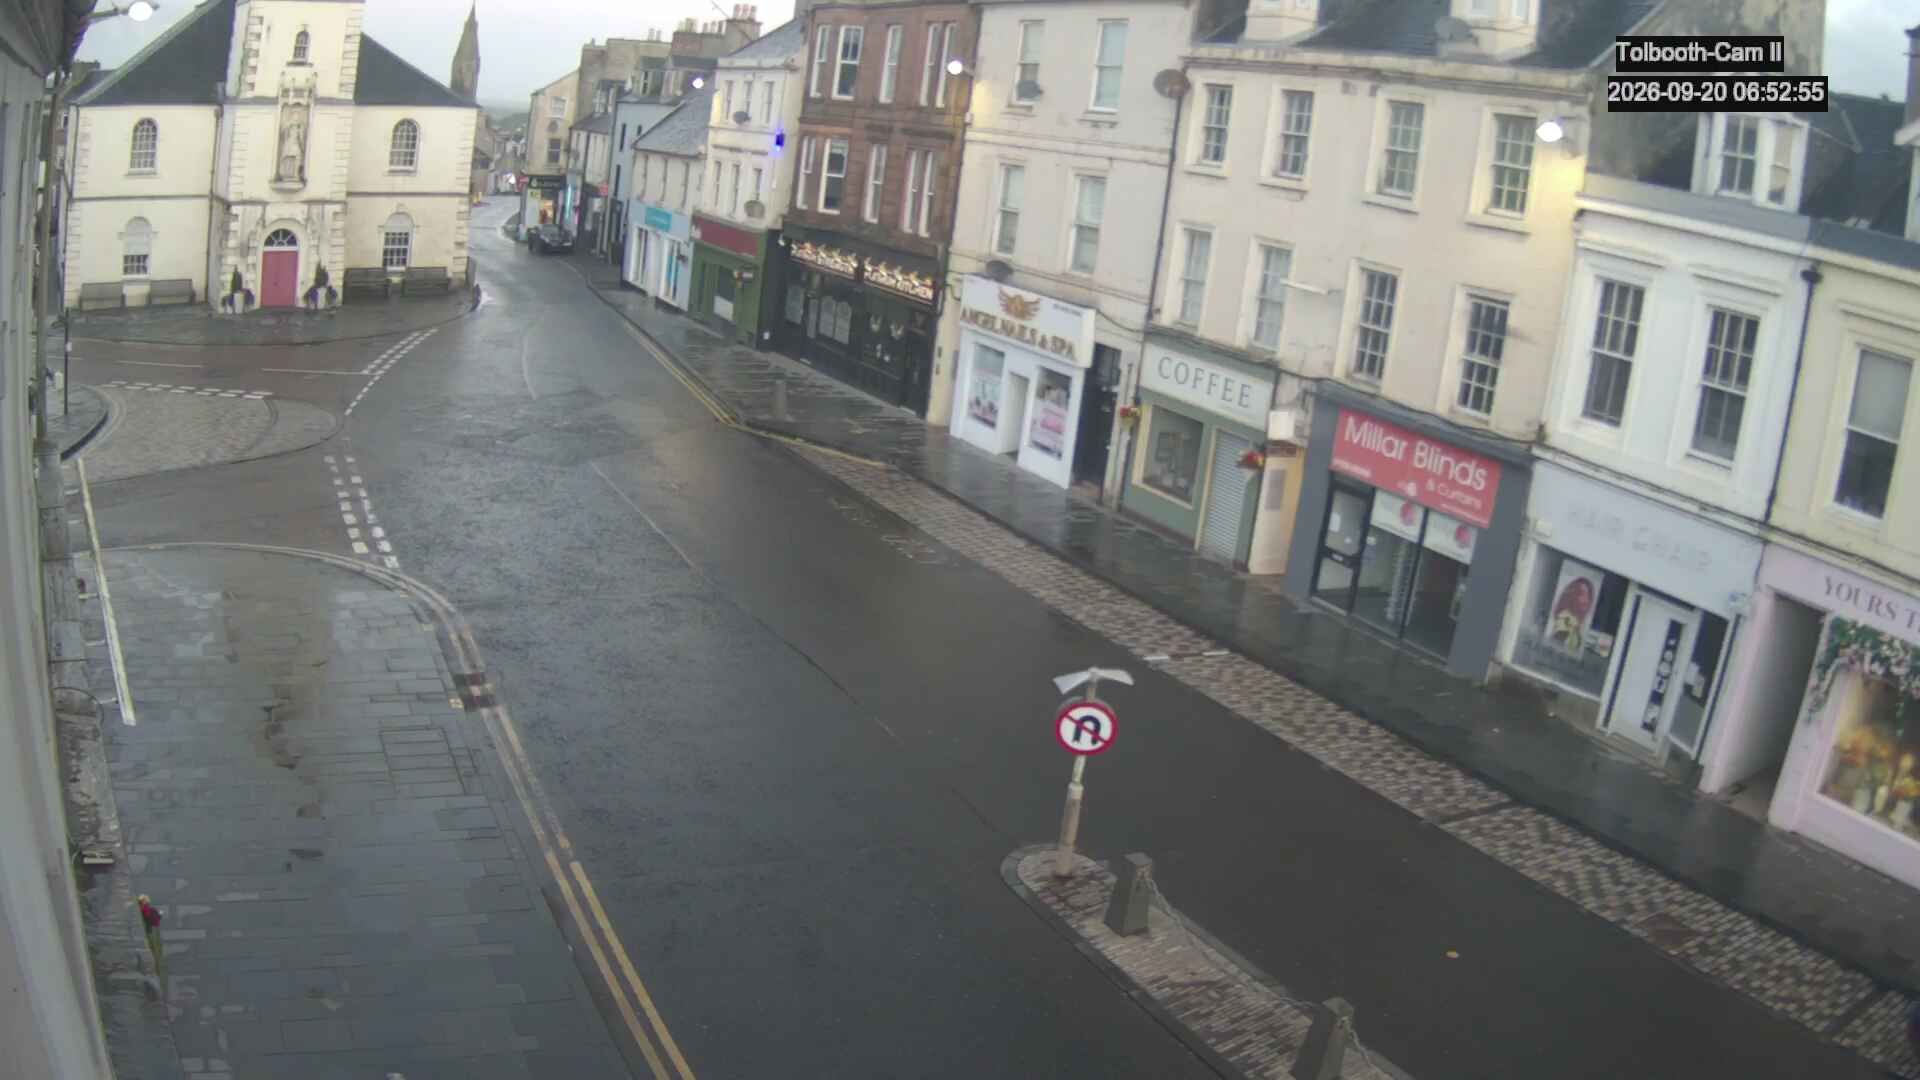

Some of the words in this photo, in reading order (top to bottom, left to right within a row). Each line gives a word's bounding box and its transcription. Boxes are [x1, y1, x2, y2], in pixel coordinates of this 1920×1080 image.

[960, 307, 1002, 333] ANGEL
[1002, 318, 1038, 347] NAILS
[1050, 335, 1076, 359] SPA
[1158, 356, 1252, 408] COFFEE
[1344, 416, 1408, 461] Millar
[1414, 440, 1488, 491] Blinds
[1825, 575, 1897, 621] YOURS
